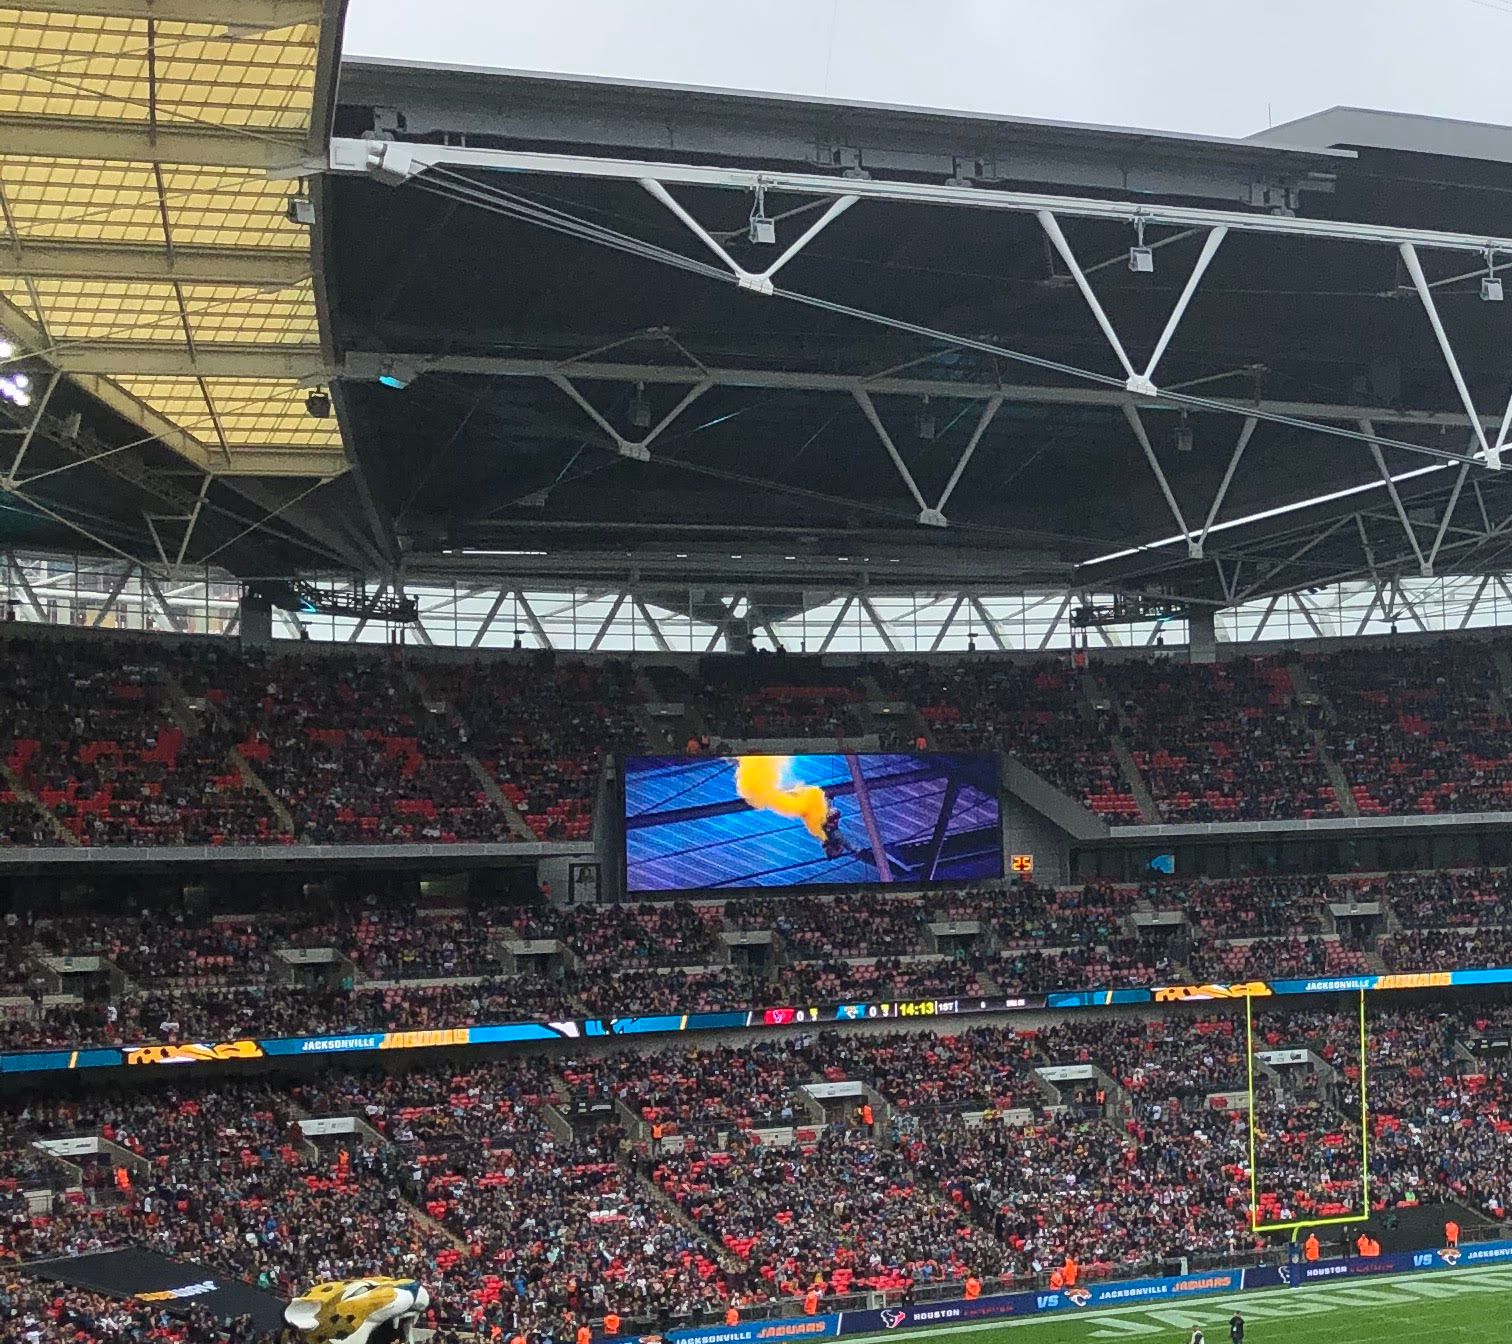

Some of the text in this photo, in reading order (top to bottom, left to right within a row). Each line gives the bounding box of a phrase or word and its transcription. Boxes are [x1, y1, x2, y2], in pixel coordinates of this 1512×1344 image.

[1013, 857, 1031, 871] 25
[1305, 979, 1370, 991] JACKSONVILLE
[900, 1001, 934, 1016] 14:13
[302, 1037, 375, 1051] JACKSONVILLE
[1306, 1265, 1347, 1277] HOUSTON
[1413, 1254, 1432, 1267] VS
[913, 1308, 960, 1321] HOUSTON
[1036, 1294, 1059, 1309] VS
[1100, 1284, 1168, 1300] JACKSONVILLE
[1172, 1276, 1231, 1293] JAGUARS
[756, 1321, 826, 1339] JAGUARS
